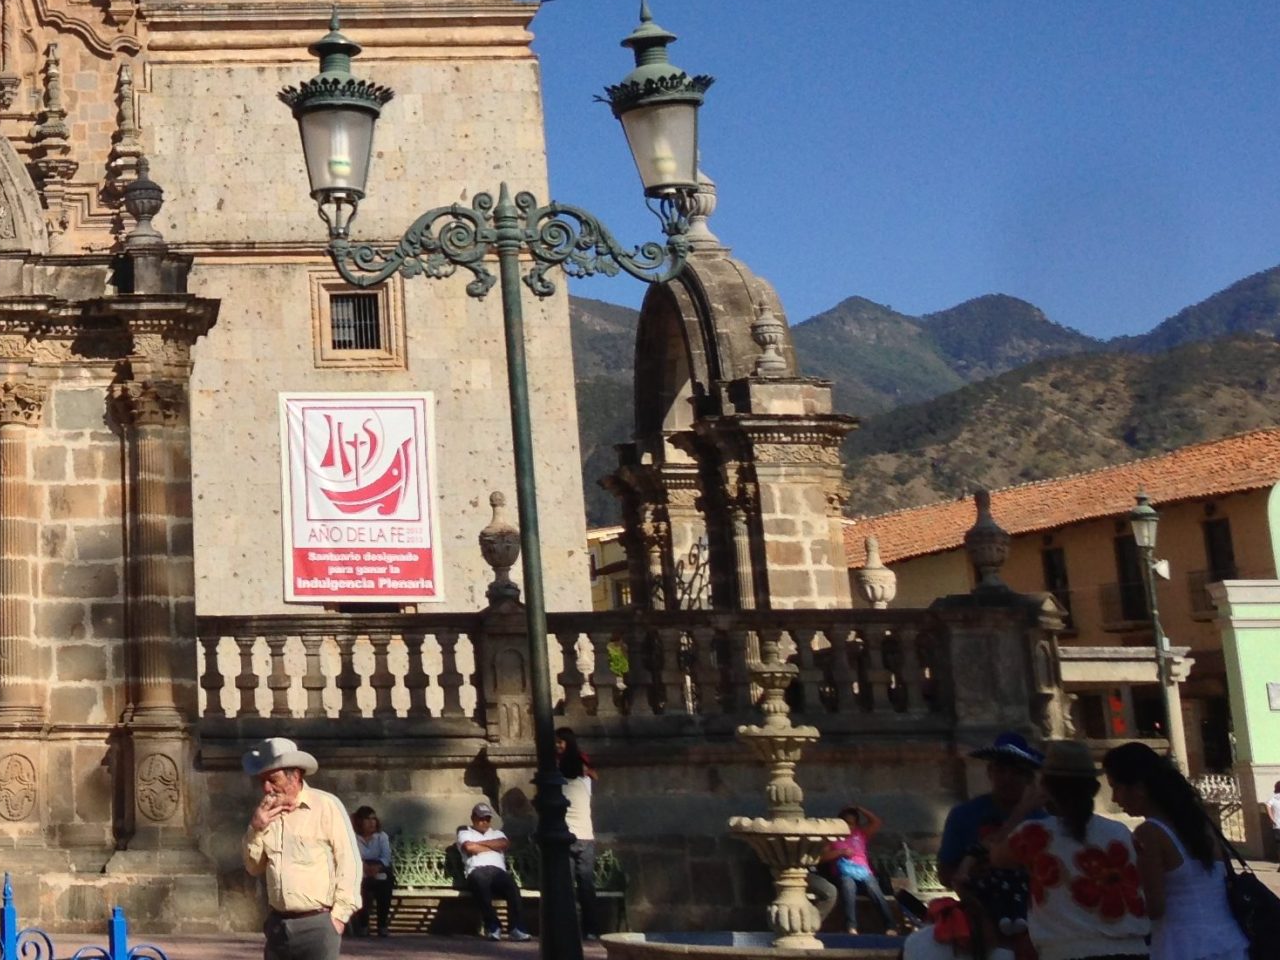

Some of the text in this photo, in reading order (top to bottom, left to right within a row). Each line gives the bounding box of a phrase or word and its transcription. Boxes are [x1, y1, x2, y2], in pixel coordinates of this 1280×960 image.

[308, 524, 405, 543] AÑO DE LA FE
[307, 551, 420, 563] Santuario designado
[328, 564, 401, 576] para ganar la
[296, 577, 434, 591] Indulgencia Plenaria
